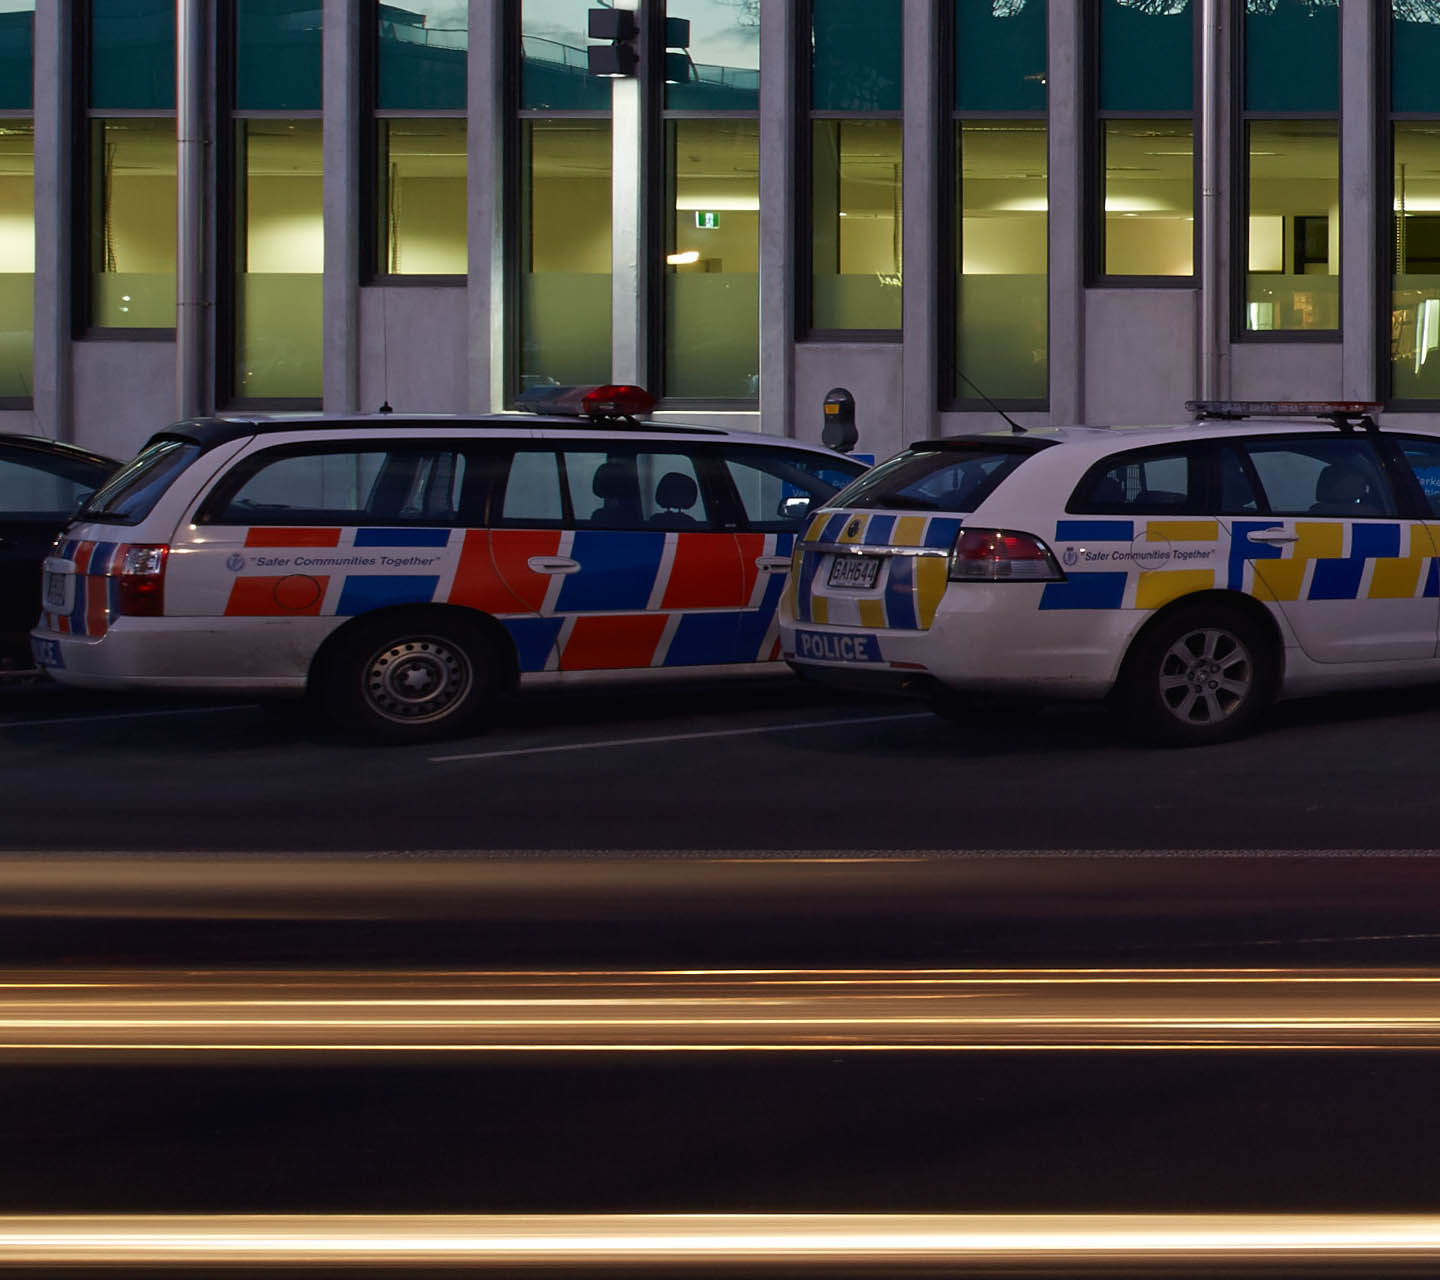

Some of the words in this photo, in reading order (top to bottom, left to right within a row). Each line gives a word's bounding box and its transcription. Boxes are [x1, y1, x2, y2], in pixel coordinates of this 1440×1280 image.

[294, 556, 376, 567] Communities
[1112, 550, 1170, 561] Communities
[833, 557, 877, 582] GAH644
[801, 634, 869, 660] POLICE
